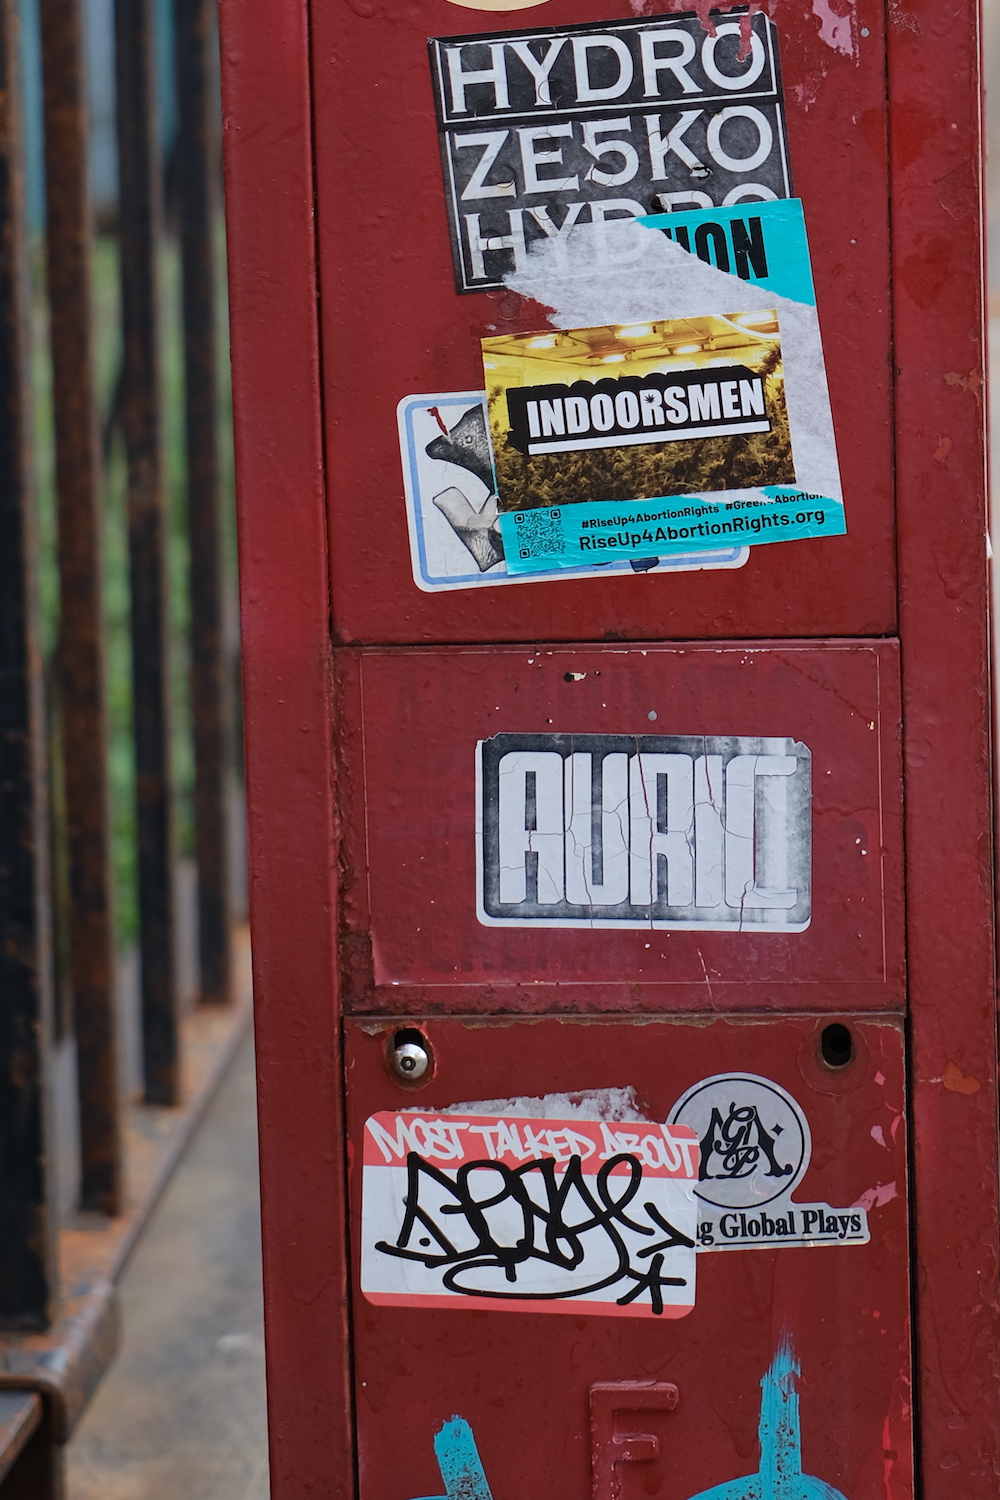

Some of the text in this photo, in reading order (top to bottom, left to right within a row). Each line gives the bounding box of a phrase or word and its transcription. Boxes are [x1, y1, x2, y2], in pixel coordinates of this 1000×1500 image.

[445, 22, 766, 114] HYDRO
[454, 104, 773, 201] ZE5KO
[463, 182, 780, 280] HYD
[526, 377, 765, 438] INDOORSMEN
[579, 508, 826, 551] RiseUp4AbortionRights.org
[581, 504, 720, 529] #RiseUp4AbortionRights
[365, 1115, 700, 1178] MOST TALKED ABOUT
[720, 1212, 797, 1238] Global
[801, 1209, 862, 1239] Plays
